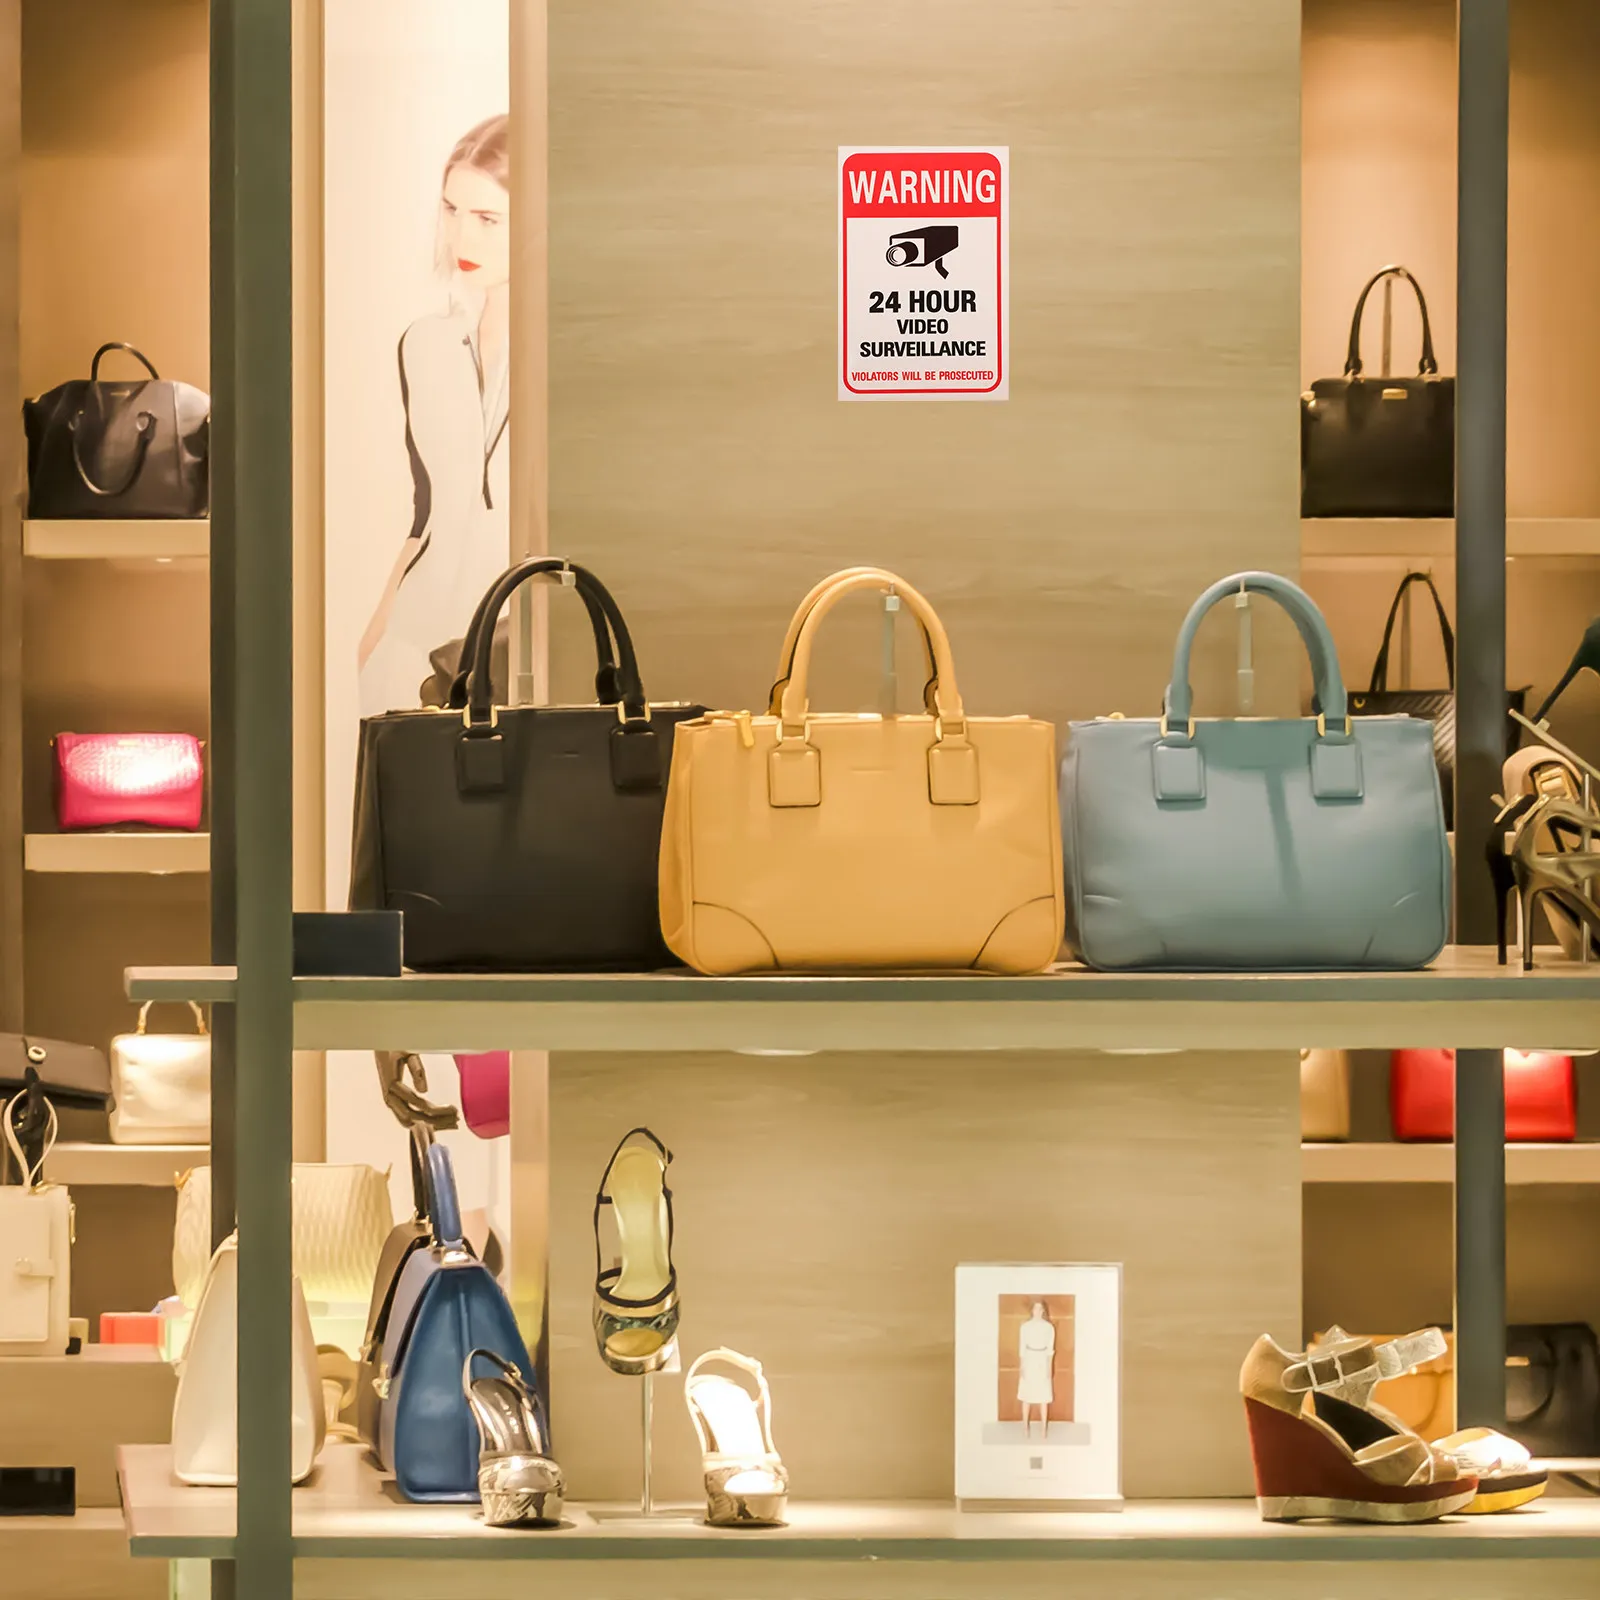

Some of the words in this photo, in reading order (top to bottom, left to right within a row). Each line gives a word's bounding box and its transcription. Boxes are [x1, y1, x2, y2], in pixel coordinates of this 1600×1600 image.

[849, 169, 996, 204] WARNING
[869, 291, 901, 313] 24
[909, 290, 977, 313] HOUR
[897, 319, 949, 335] VIDEO
[860, 341, 986, 357] SURVEILLANCE
[852, 371, 899, 382] VIOLATORS
[902, 371, 922, 381] WILL
[925, 371, 936, 381] BE
[939, 371, 994, 381] PROSECUTED
